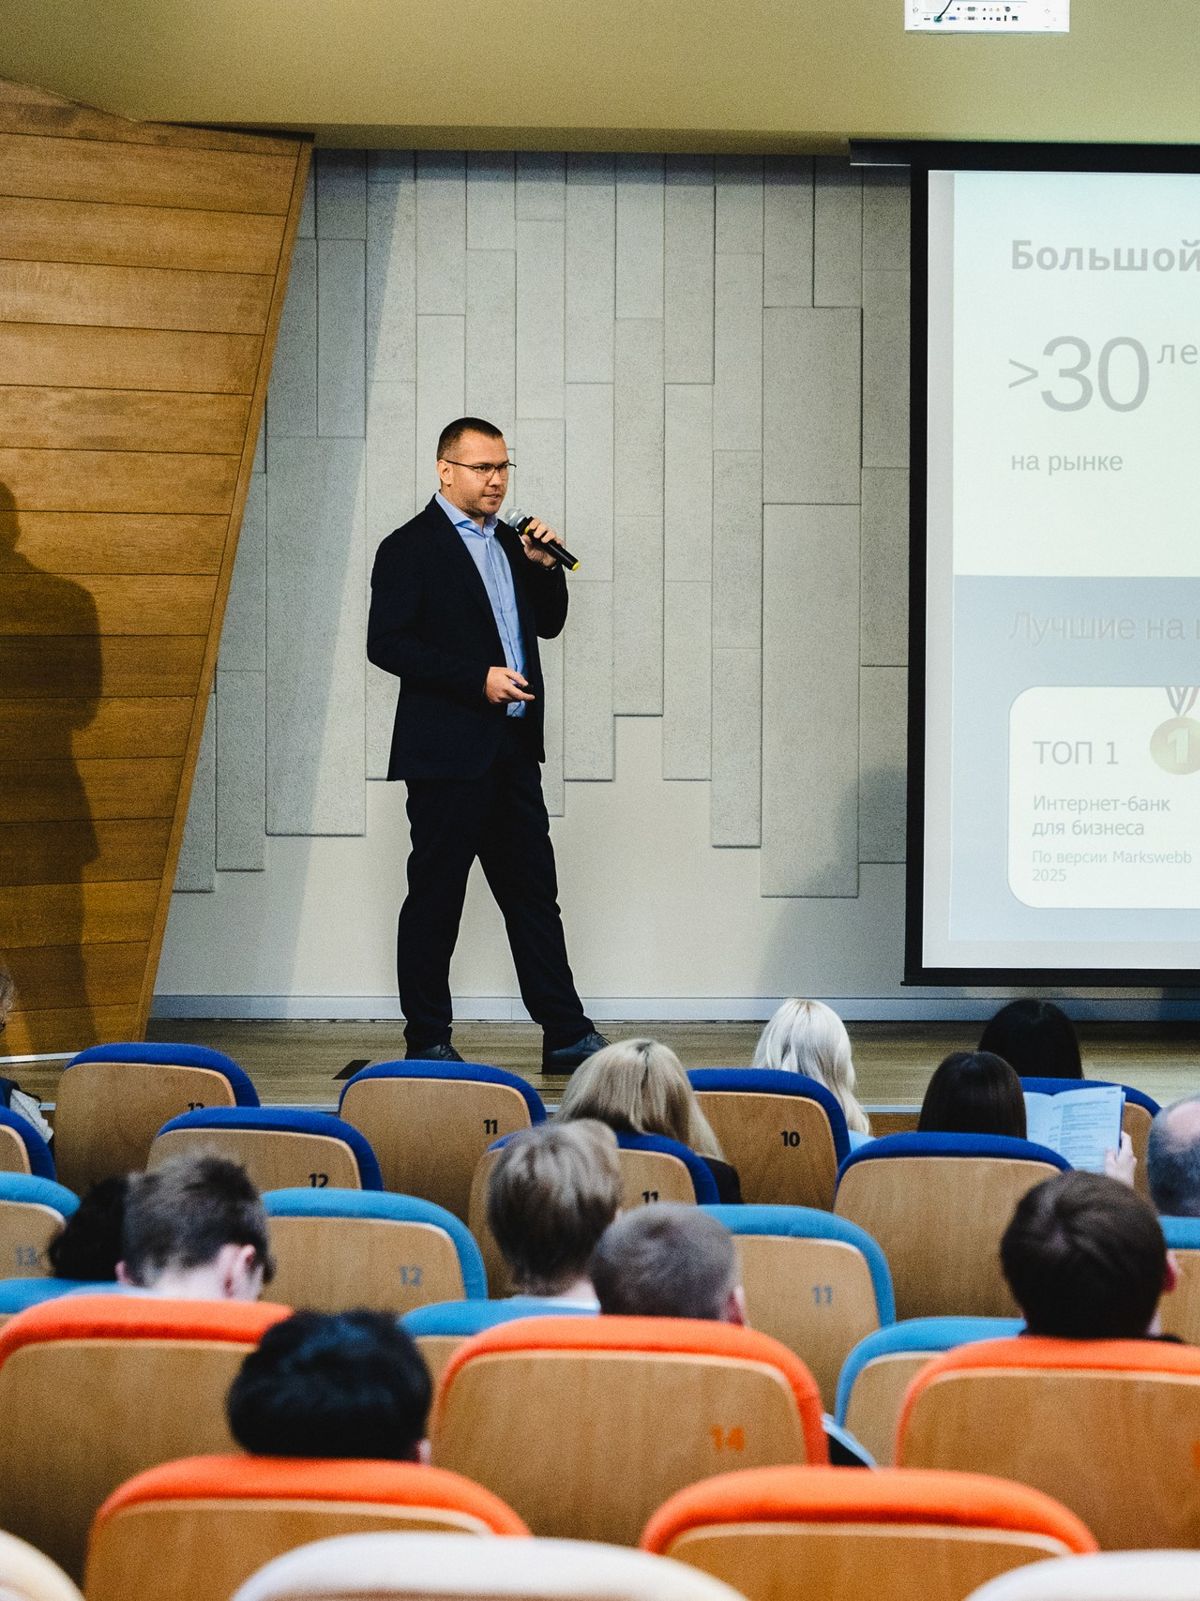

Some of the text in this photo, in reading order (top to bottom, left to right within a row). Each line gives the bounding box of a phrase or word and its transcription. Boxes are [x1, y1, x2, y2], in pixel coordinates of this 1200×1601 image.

[1008, 335, 1150, 413] >30
[1011, 454, 1124, 476] на рынке
[1009, 611, 1138, 650] Лучшие
[1147, 616, 1187, 641] на
[1032, 740, 1119, 766] ТОП 1
[1165, 728, 1193, 764] 1
[1033, 795, 1171, 815] Интернет-банк
[1031, 819, 1145, 837] для бизнеса
[1031, 849, 1193, 867] По версии Markswebb
[1032, 867, 1068, 883] 2025
[483, 1118, 498, 1135] 11
[780, 1131, 801, 1147] 10
[308, 1173, 328, 1188] 12
[642, 1191, 658, 1204] 11
[400, 1265, 422, 1287] 12
[813, 1285, 832, 1306] 11
[710, 1425, 745, 1451] 14
